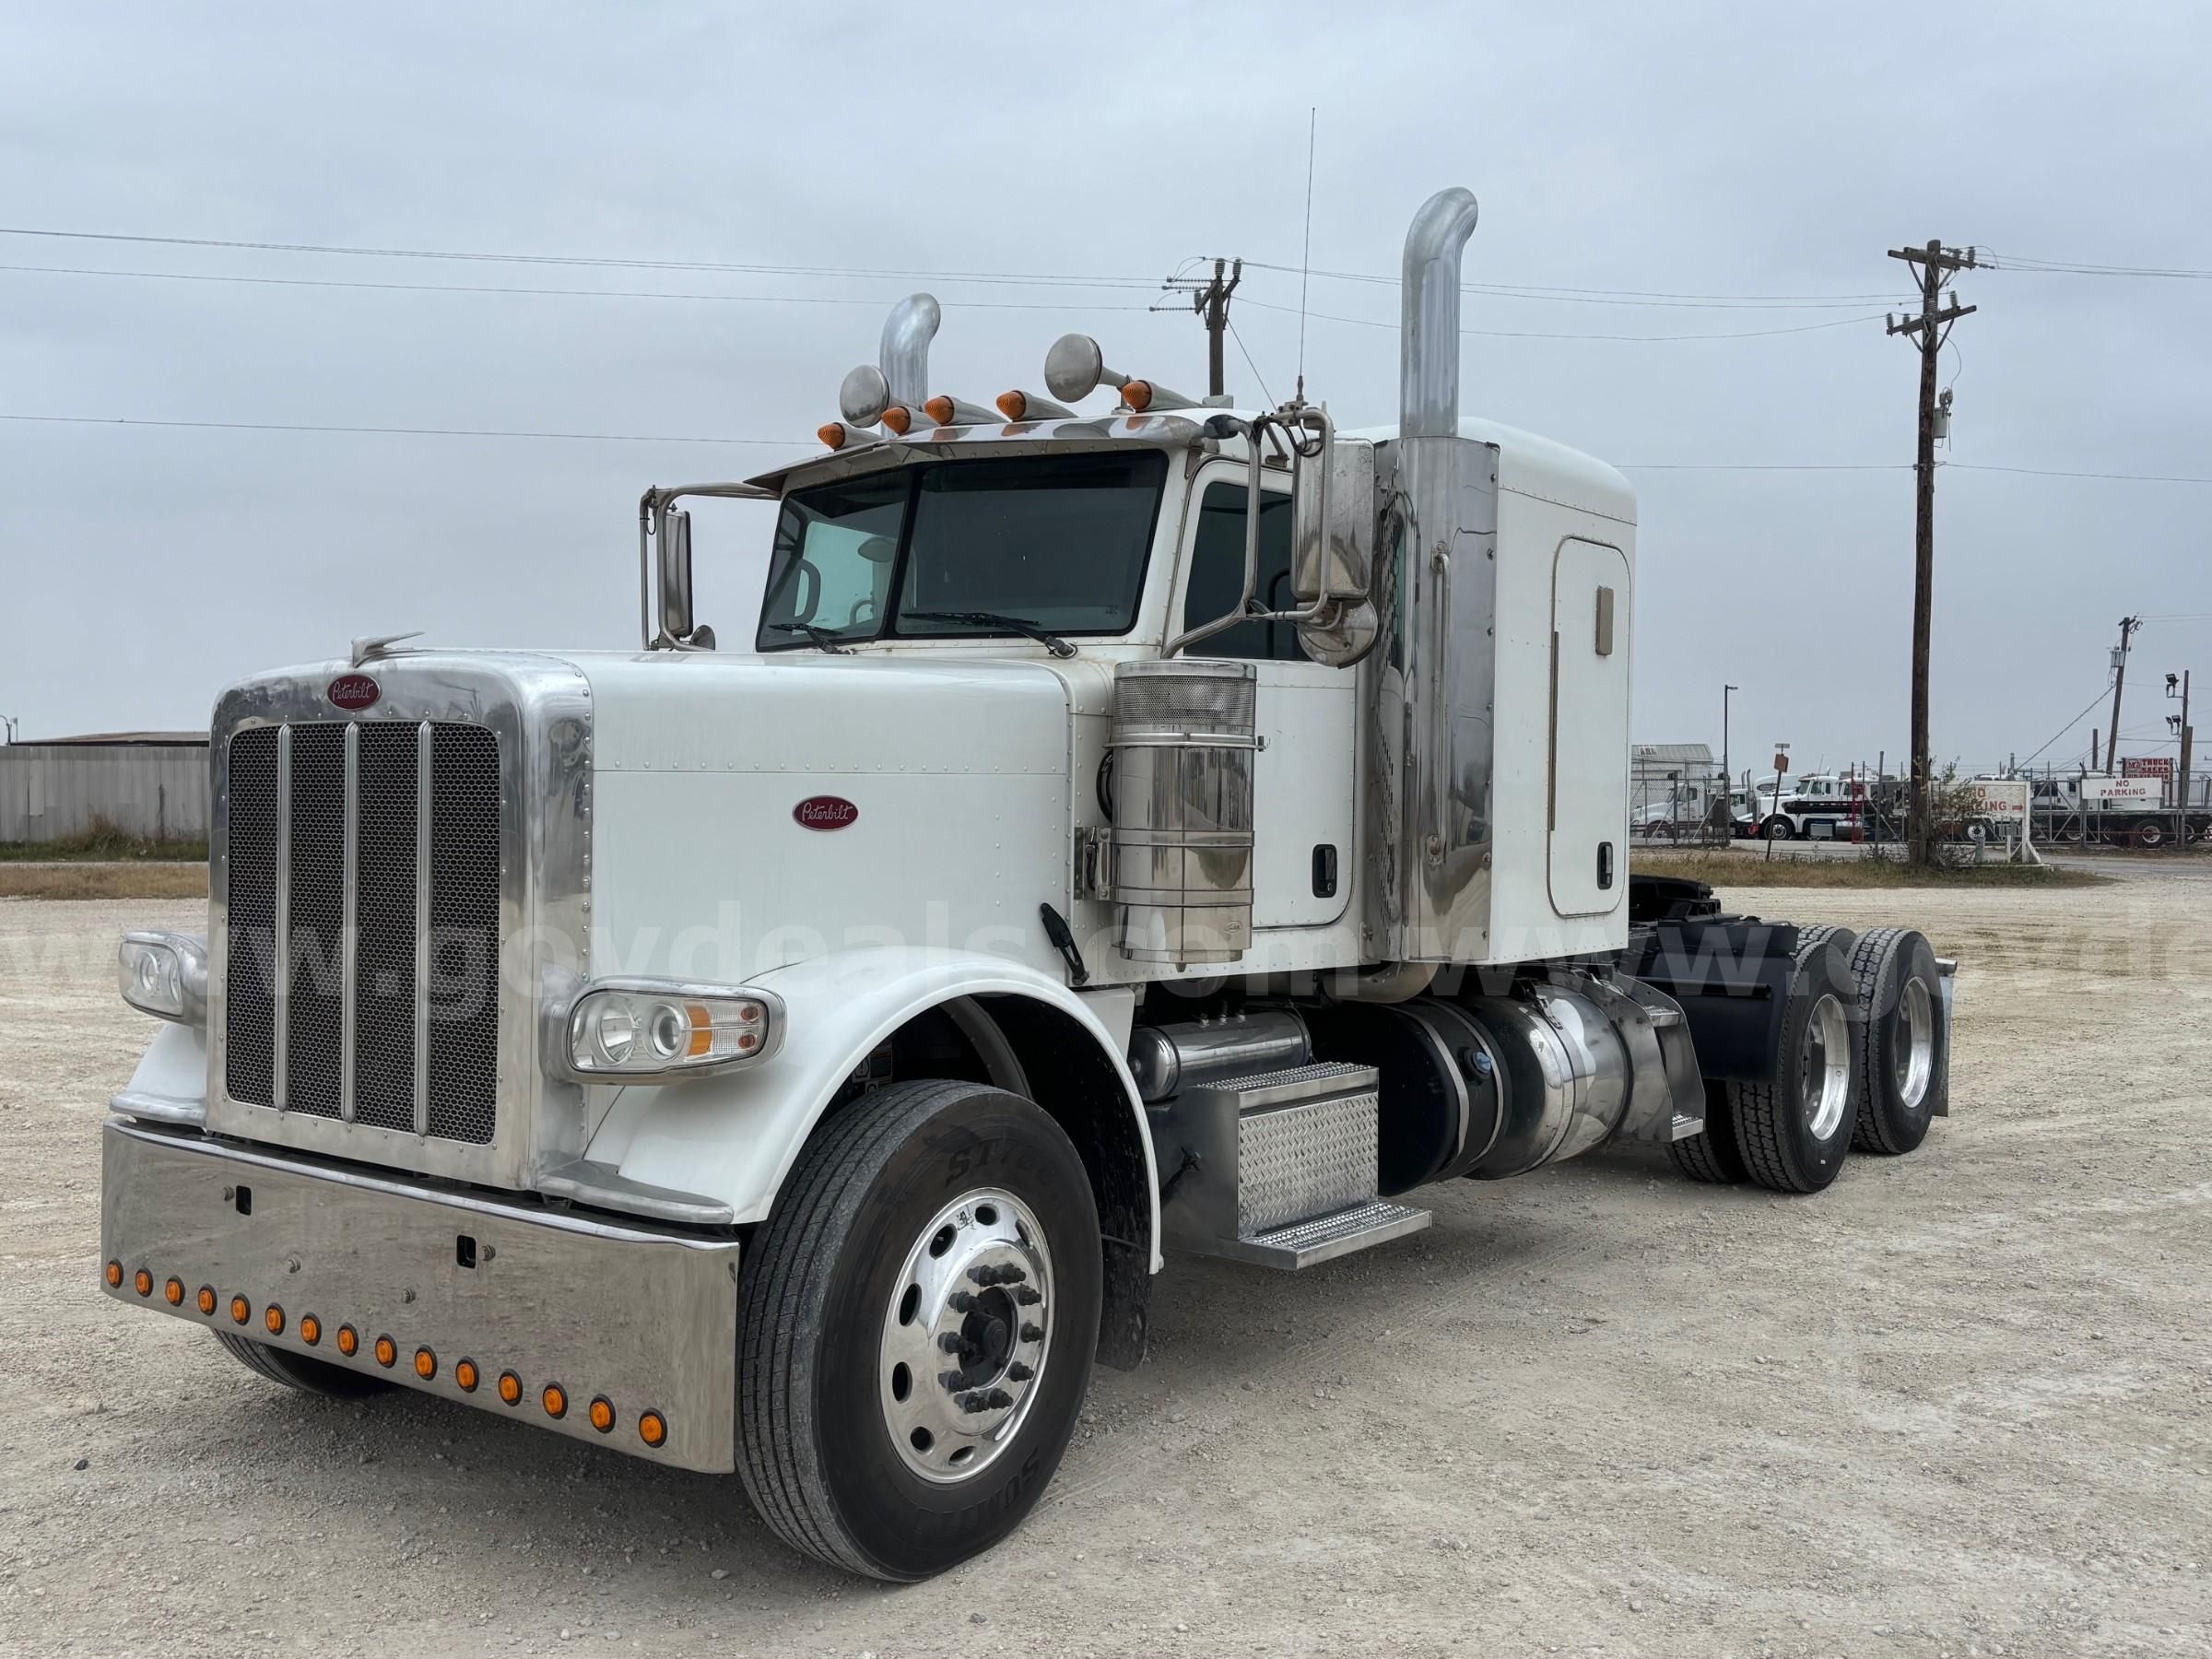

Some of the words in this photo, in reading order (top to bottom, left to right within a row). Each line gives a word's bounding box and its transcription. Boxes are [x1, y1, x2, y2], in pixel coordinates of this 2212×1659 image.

[333, 681, 374, 700] Peterbilt
[2100, 788, 2147, 796] PARKING
[802, 802, 853, 821] Peterbilt
